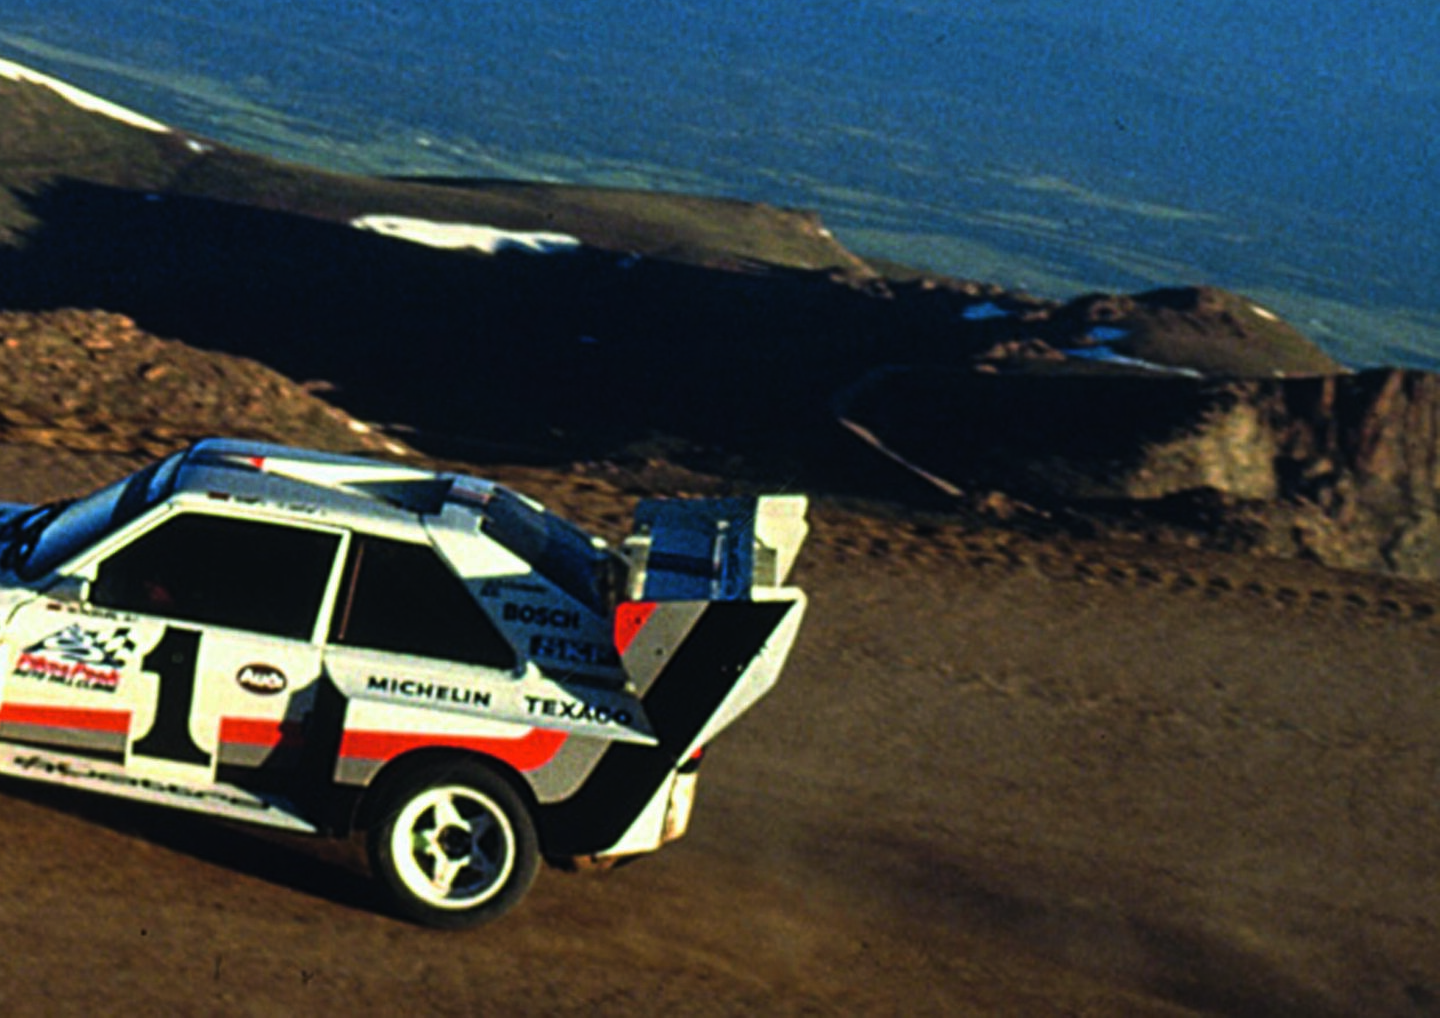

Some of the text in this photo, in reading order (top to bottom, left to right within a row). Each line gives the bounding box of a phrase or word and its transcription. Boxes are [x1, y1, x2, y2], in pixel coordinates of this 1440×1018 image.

[502, 601, 581, 629] BOSCH
[132, 625, 212, 768] 1
[366, 676, 492, 708] MICHELIN
[524, 695, 633, 726] TEXACO
